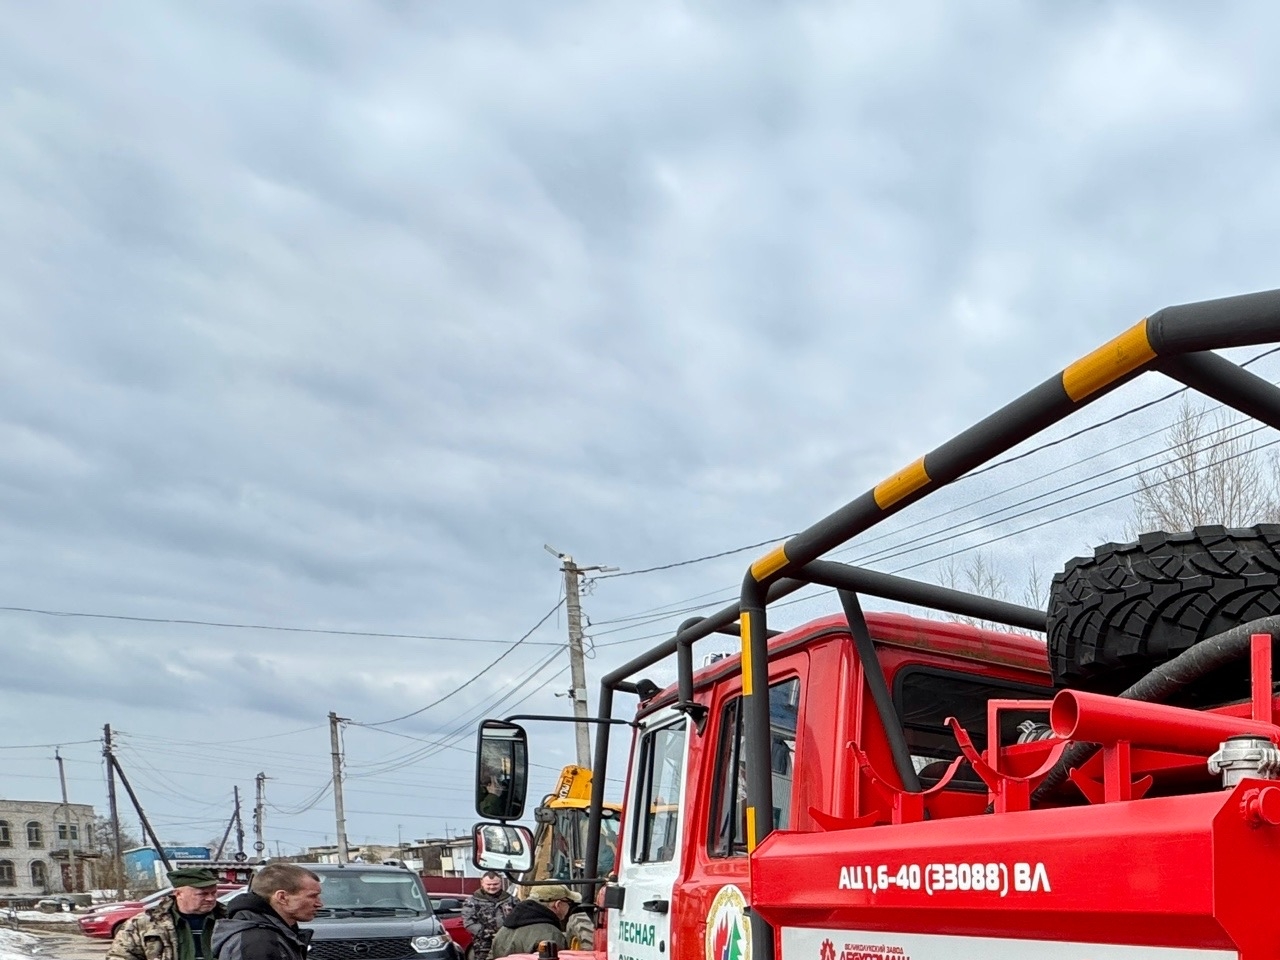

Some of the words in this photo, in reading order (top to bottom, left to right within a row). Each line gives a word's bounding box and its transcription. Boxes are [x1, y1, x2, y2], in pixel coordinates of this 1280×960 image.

[925, 862, 1009, 898] (33088)
[1013, 862, 1052, 892] ВЛ
[618, 920, 656, 947] ЛЕСНАЯ
[886, 945, 904, 955] ЗАВОД
